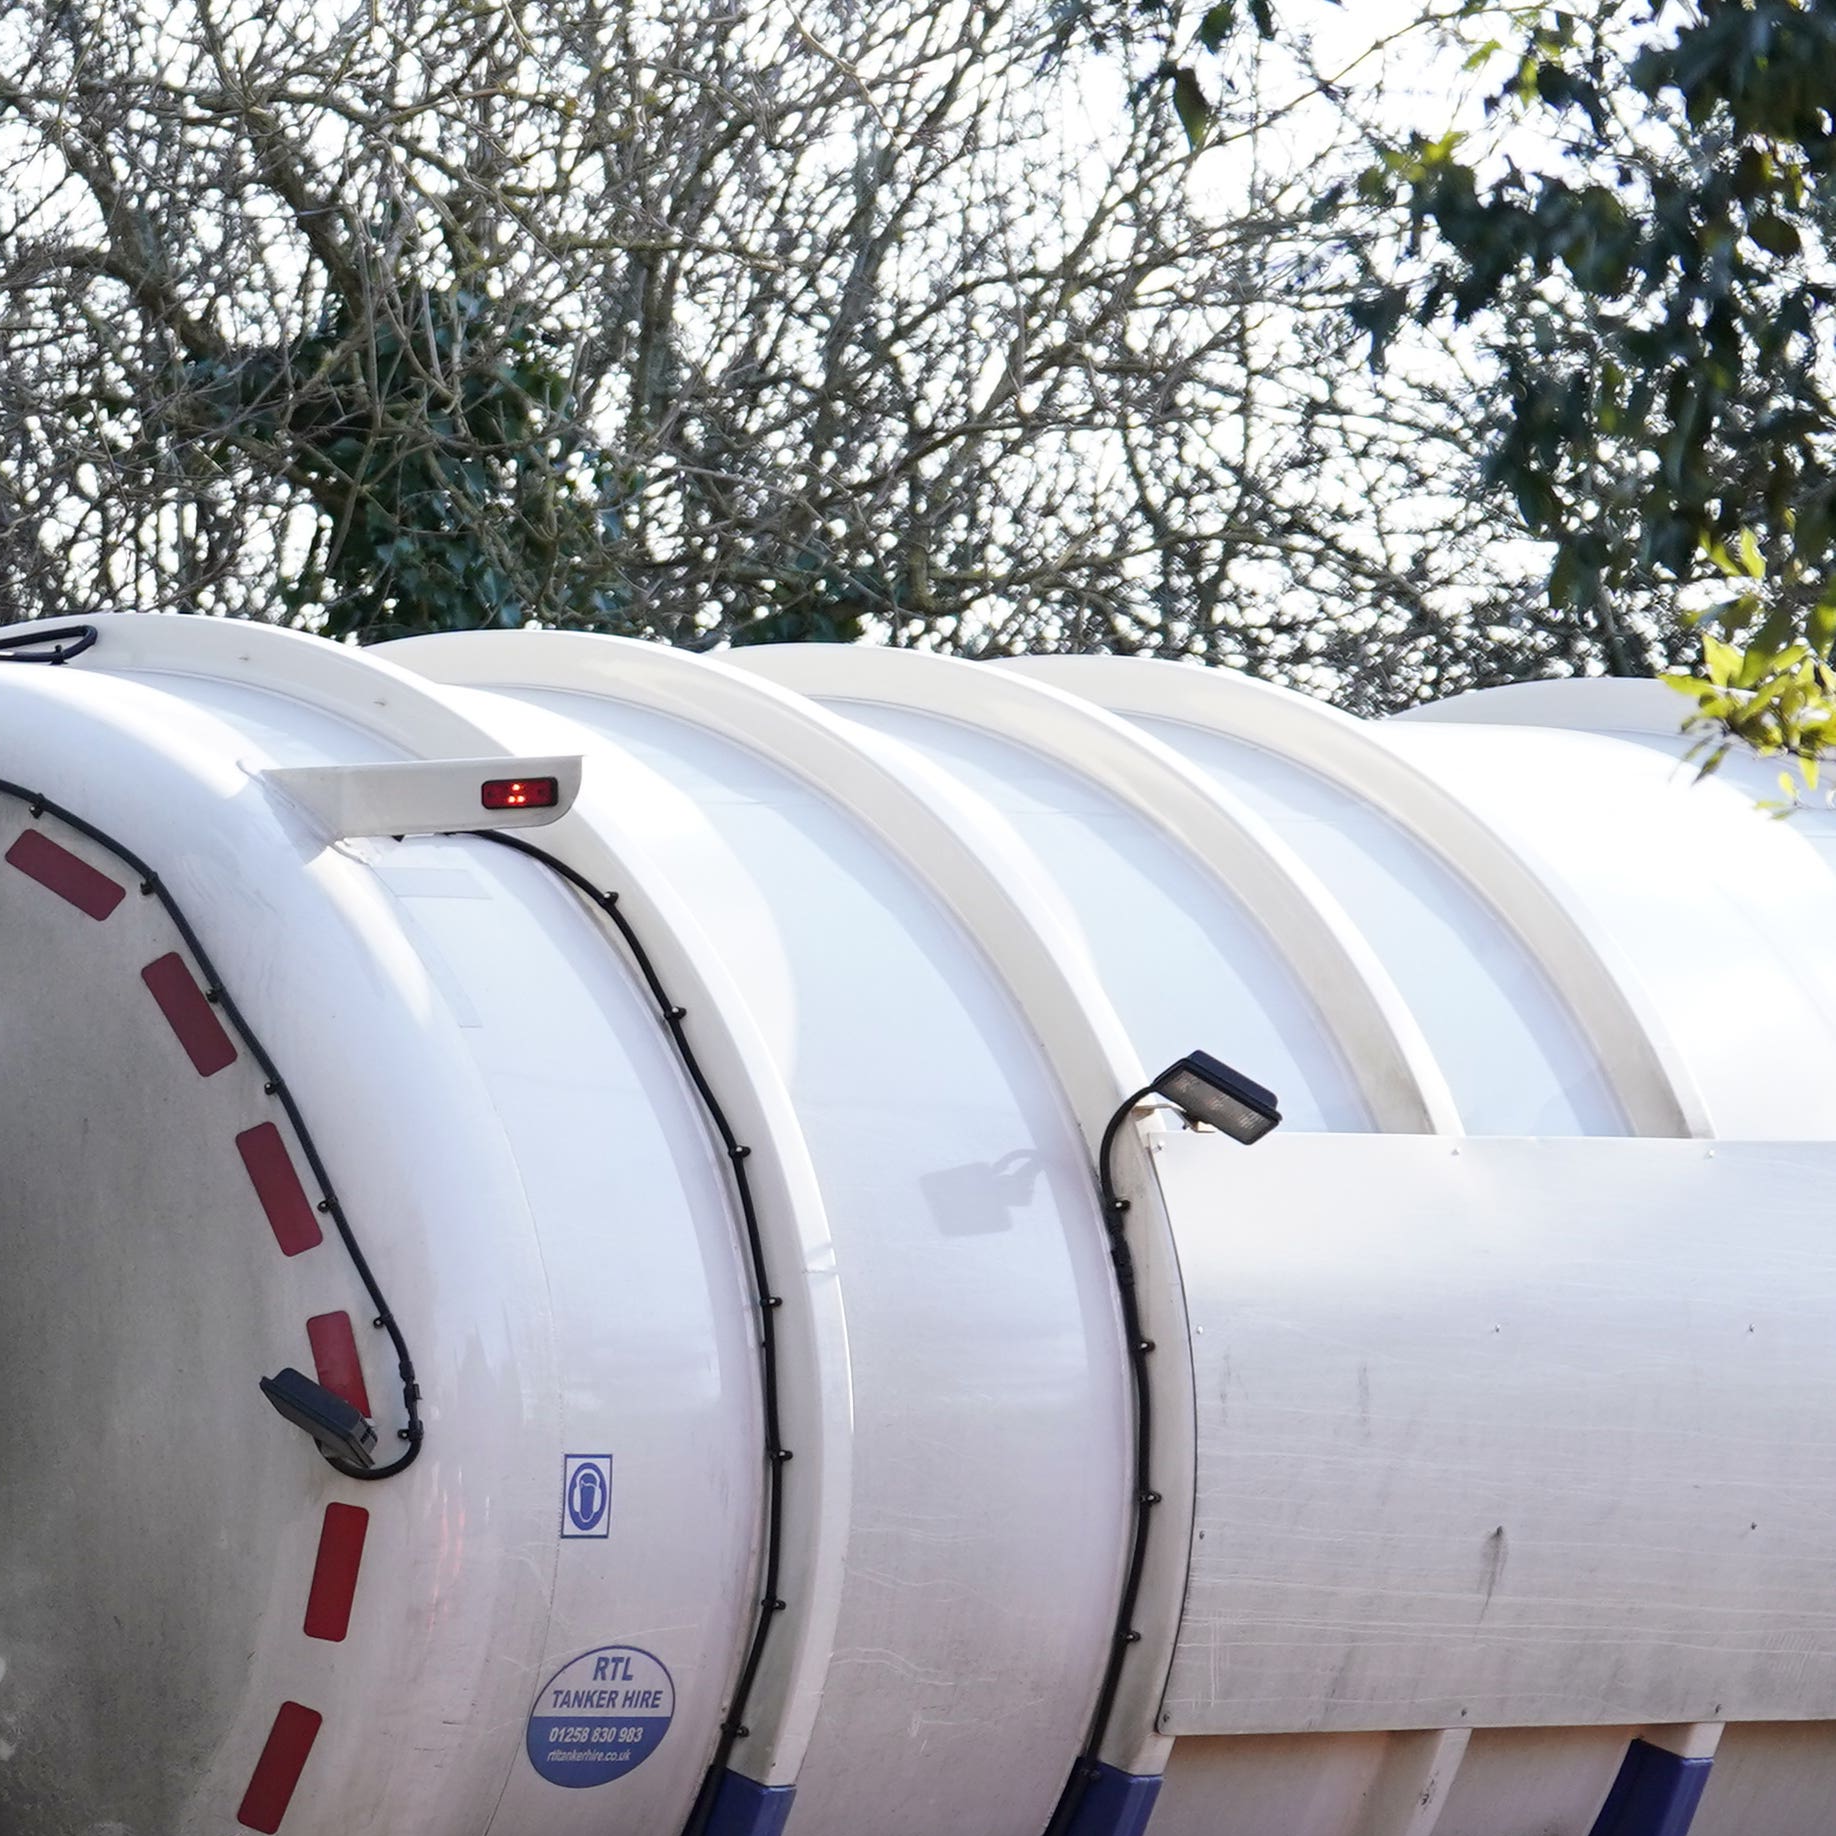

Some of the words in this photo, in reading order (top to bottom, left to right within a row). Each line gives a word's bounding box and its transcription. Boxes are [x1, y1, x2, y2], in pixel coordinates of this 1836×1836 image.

[592, 1656, 634, 1681] RTL
[552, 1689, 617, 1709] TANKER
[621, 1690, 663, 1709] HIRE
[549, 1727, 590, 1742] 01258
[591, 1727, 616, 1742] 830
[617, 1727, 643, 1743] 983
